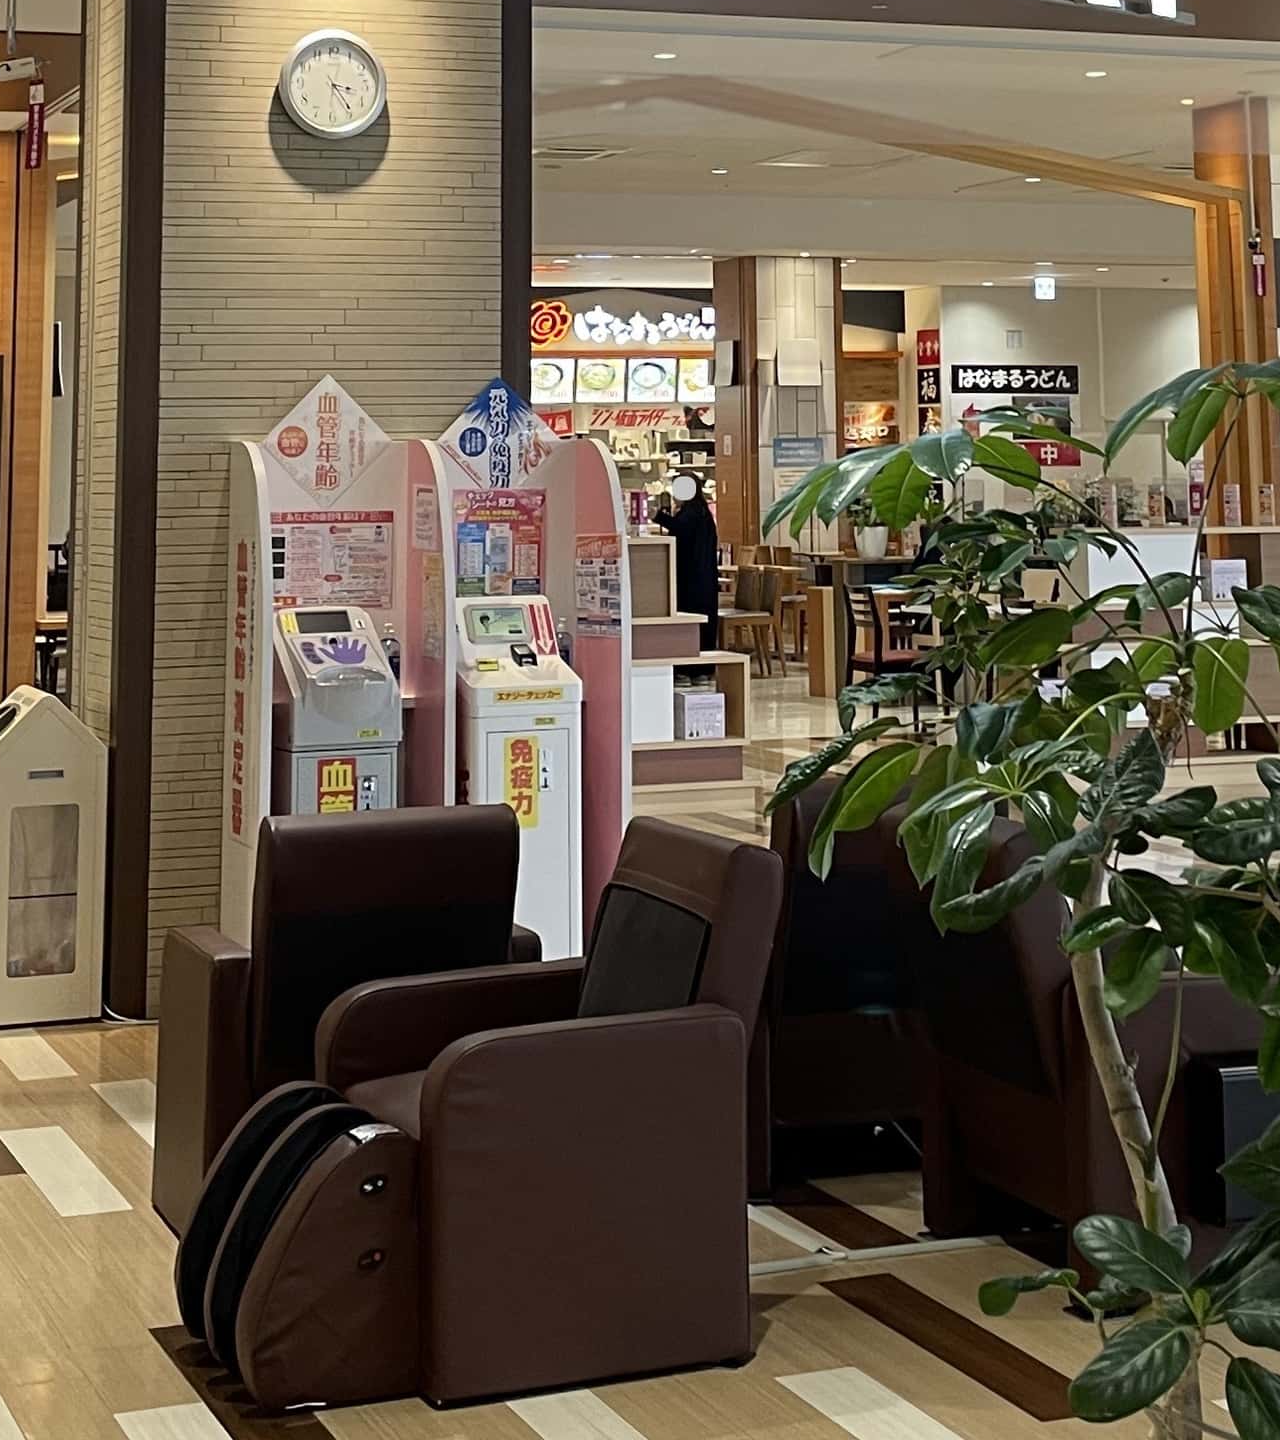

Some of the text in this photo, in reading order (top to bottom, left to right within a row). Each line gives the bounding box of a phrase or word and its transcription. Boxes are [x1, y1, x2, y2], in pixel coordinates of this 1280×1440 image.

[958, 368, 1071, 389] はなまるうどん
[314, 392, 340, 491] 血管年齢
[510, 739, 533, 816] 免疫力
